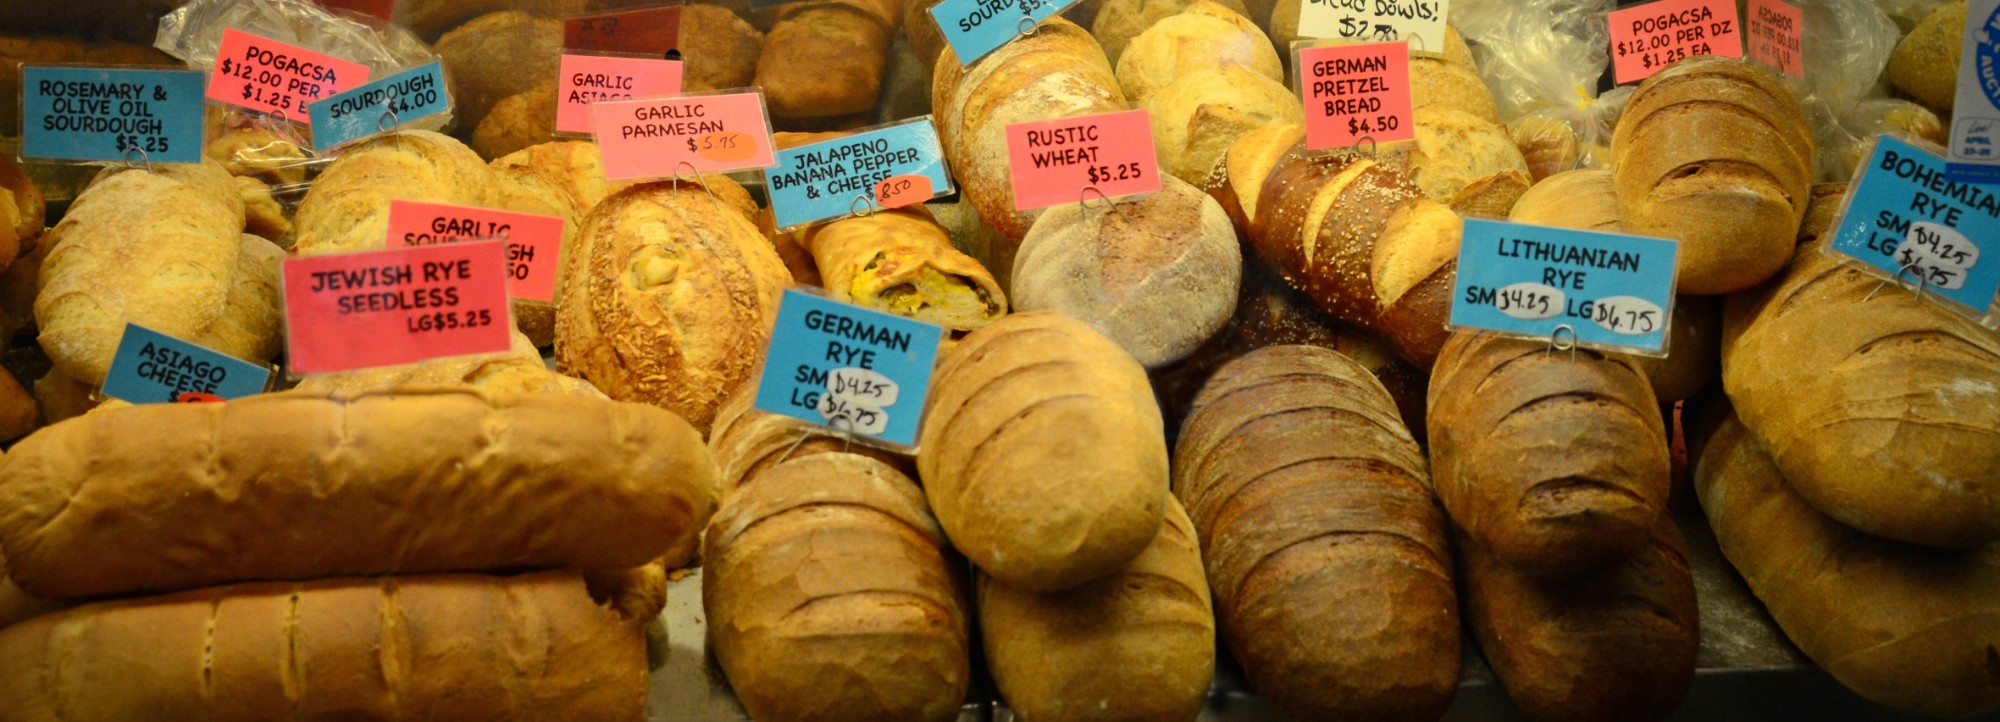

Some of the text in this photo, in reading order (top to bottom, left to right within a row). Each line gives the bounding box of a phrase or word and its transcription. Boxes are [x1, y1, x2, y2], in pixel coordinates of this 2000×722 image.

[1632, 5, 1712, 36] POGACSA
[1618, 20, 1732, 57] $12.00 PER DZ
[246, 46, 336, 85] POGACSA
[1313, 55, 1387, 77] GERMAN
[1643, 42, 1711, 69] $1.25 EA
[39, 80, 167, 101] ROSEMARY &
[221, 58, 321, 99] $12.00 PER
[572, 73, 633, 90] GARLIC
[1313, 76, 1389, 98] PRETZEL
[52, 97, 153, 117] OLIVE OIL
[242, 83, 291, 110] $1.25
[330, 73, 434, 119] SOURDOUGH
[387, 89, 437, 115] $4.00
[1324, 97, 1381, 117] BREAD
[43, 115, 162, 135] SOURDOUGH
[635, 104, 705, 121] GARLIC
[1348, 115, 1398, 136] $4.50
[116, 133, 168, 153] $5.25
[622, 120, 724, 139] PARMESAN
[1027, 125, 1099, 148] RUSTIC
[794, 138, 889, 170] JALAPENO
[1031, 146, 1099, 169] WHEAT
[771, 147, 920, 190] BANANA PEPPER
[1088, 163, 1141, 185] $5.25
[807, 169, 893, 200] & CHEESE
[1880, 150, 2000, 219] BOHEMIA
[1910, 191, 1963, 228] RYE
[432, 216, 511, 237] GARLIC
[1876, 210, 1911, 238] SM
[1498, 237, 1640, 272] LITHUANIAN
[1867, 231, 1898, 257] LG
[311, 260, 471, 292] JEWISH RYE
[1543, 267, 1586, 290] RYE
[338, 287, 460, 315] SEEDLESS
[1465, 285, 1497, 306] SM
[1567, 299, 1594, 319] LG
[805, 310, 911, 353] GERMAN
[139, 341, 226, 384] ASIAGO
[826, 341, 876, 370] RYE
[137, 361, 218, 395] CHEESE
[795, 365, 829, 389] SM
[790, 388, 820, 411] LG
